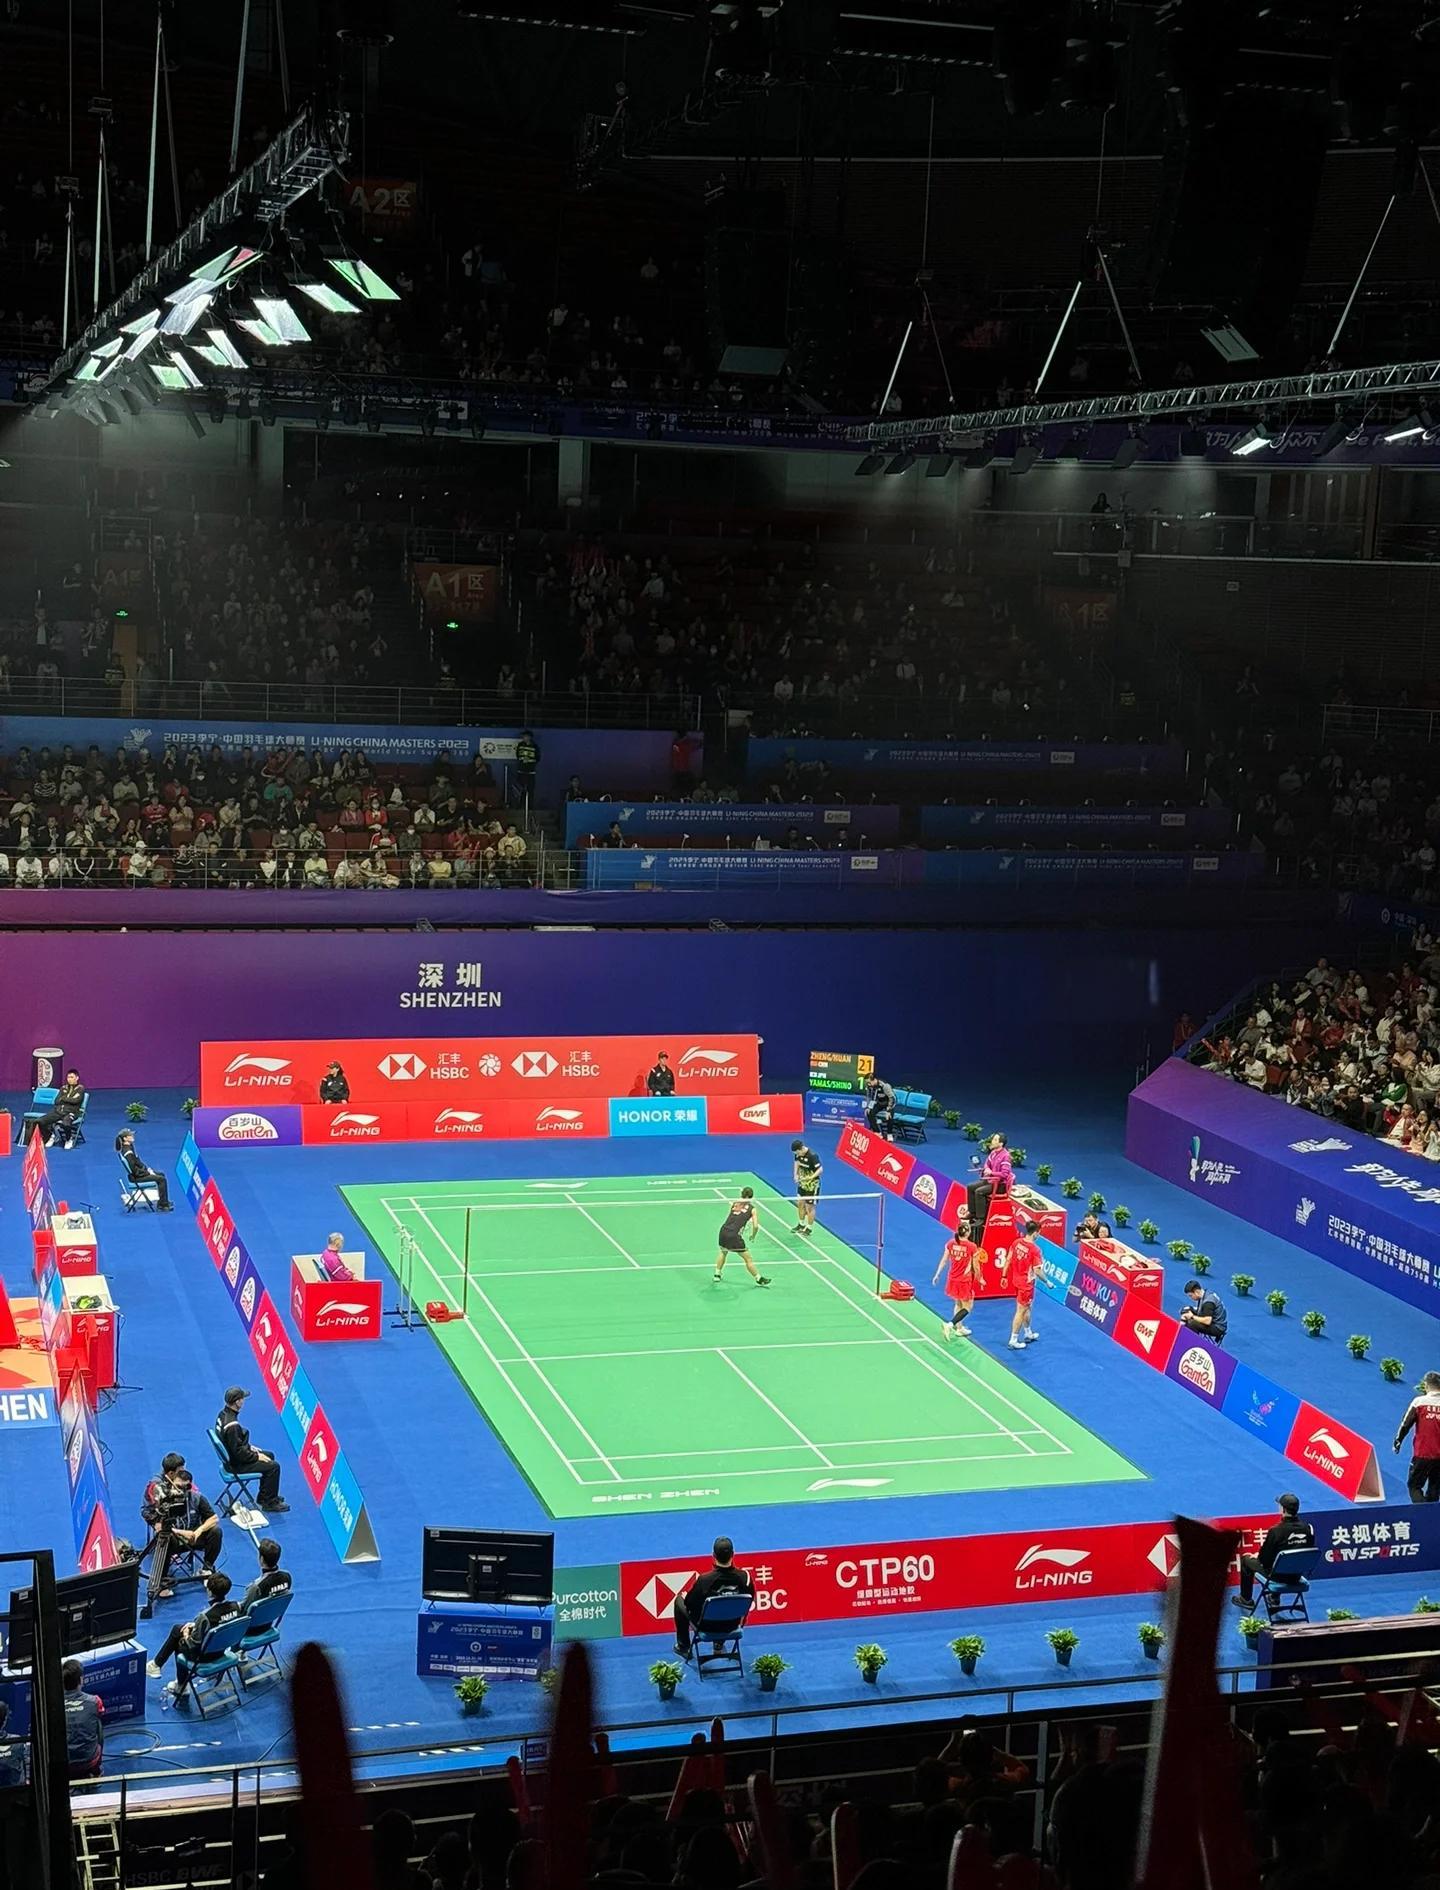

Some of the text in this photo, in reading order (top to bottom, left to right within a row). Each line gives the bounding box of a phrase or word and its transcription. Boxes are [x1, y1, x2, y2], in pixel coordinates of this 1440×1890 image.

[424, 571, 485, 598] A1区
[311, 736, 469, 749] LI-NING CHINA MASTERS 2023
[418, 963, 481, 988] 深圳
[400, 991, 501, 1008] SHENZHEN
[437, 1053, 461, 1065] 汇丰
[569, 1050, 592, 1063] 汇丰
[562, 1064, 600, 1077] HSBC
[678, 1066, 739, 1077] LI-NING
[859, 1059, 873, 1072] 21
[430, 1066, 470, 1080] HSBC
[224, 1075, 293, 1087] LI-NING
[857, 1077, 865, 1090] 1
[619, 1109, 698, 1123] HONOR 荣耀
[742, 1110, 768, 1119] BWF
[228, 1117, 262, 1127] 百岁山
[434, 1123, 484, 1134] LI-NING
[535, 1120, 584, 1131] LI-NING
[330, 1127, 380, 1137] LI-NING
[877, 1167, 900, 1185] LI-NING
[61, 1256, 92, 1264] LI-NING
[994, 1247, 1007, 1269] 3
[1082, 1250, 1108, 1272] LI-NING
[1081, 1272, 1111, 1303] YOUKU
[316, 1316, 370, 1327] LI-NING
[1136, 1322, 1155, 1340] BWF
[1188, 1350, 1212, 1371] 百岁山
[1303, 1445, 1344, 1479] LI-NING
[591, 1488, 720, 1503] SHEN ZHEN
[1332, 1521, 1411, 1546] 央视体育
[1357, 1543, 1421, 1560] SPORTS
[836, 1554, 935, 1588] CTP60
[1015, 1570, 1093, 1589] LI-NING
[559, 1605, 607, 1622] 全棉时代
